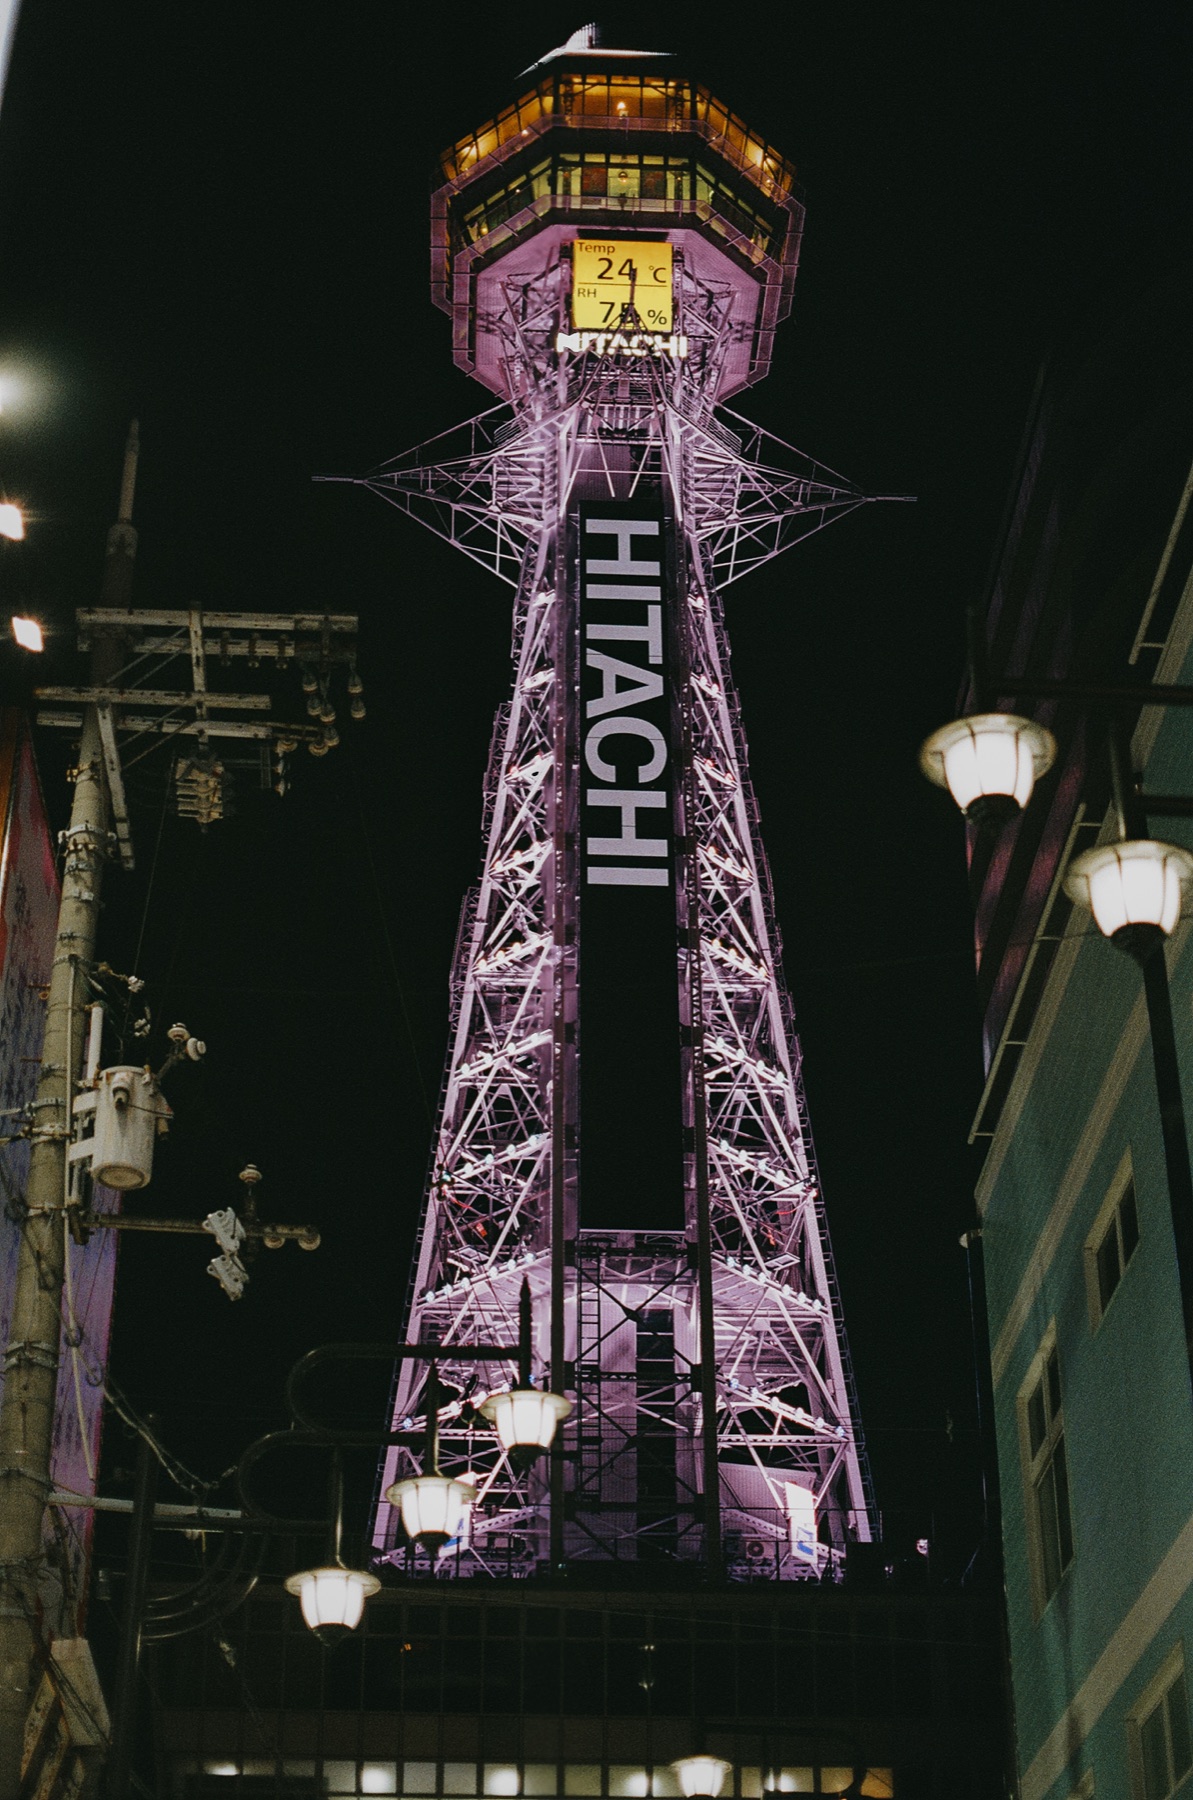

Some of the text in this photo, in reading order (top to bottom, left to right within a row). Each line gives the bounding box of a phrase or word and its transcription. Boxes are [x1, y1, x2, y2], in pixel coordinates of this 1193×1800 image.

[577, 242, 616, 255] Temp
[596, 257, 634, 281] 24
[577, 287, 597, 298] RH
[647, 309, 667, 325] %
[556, 332, 688, 358] HITACHI
[584, 518, 670, 887] HITACHI
